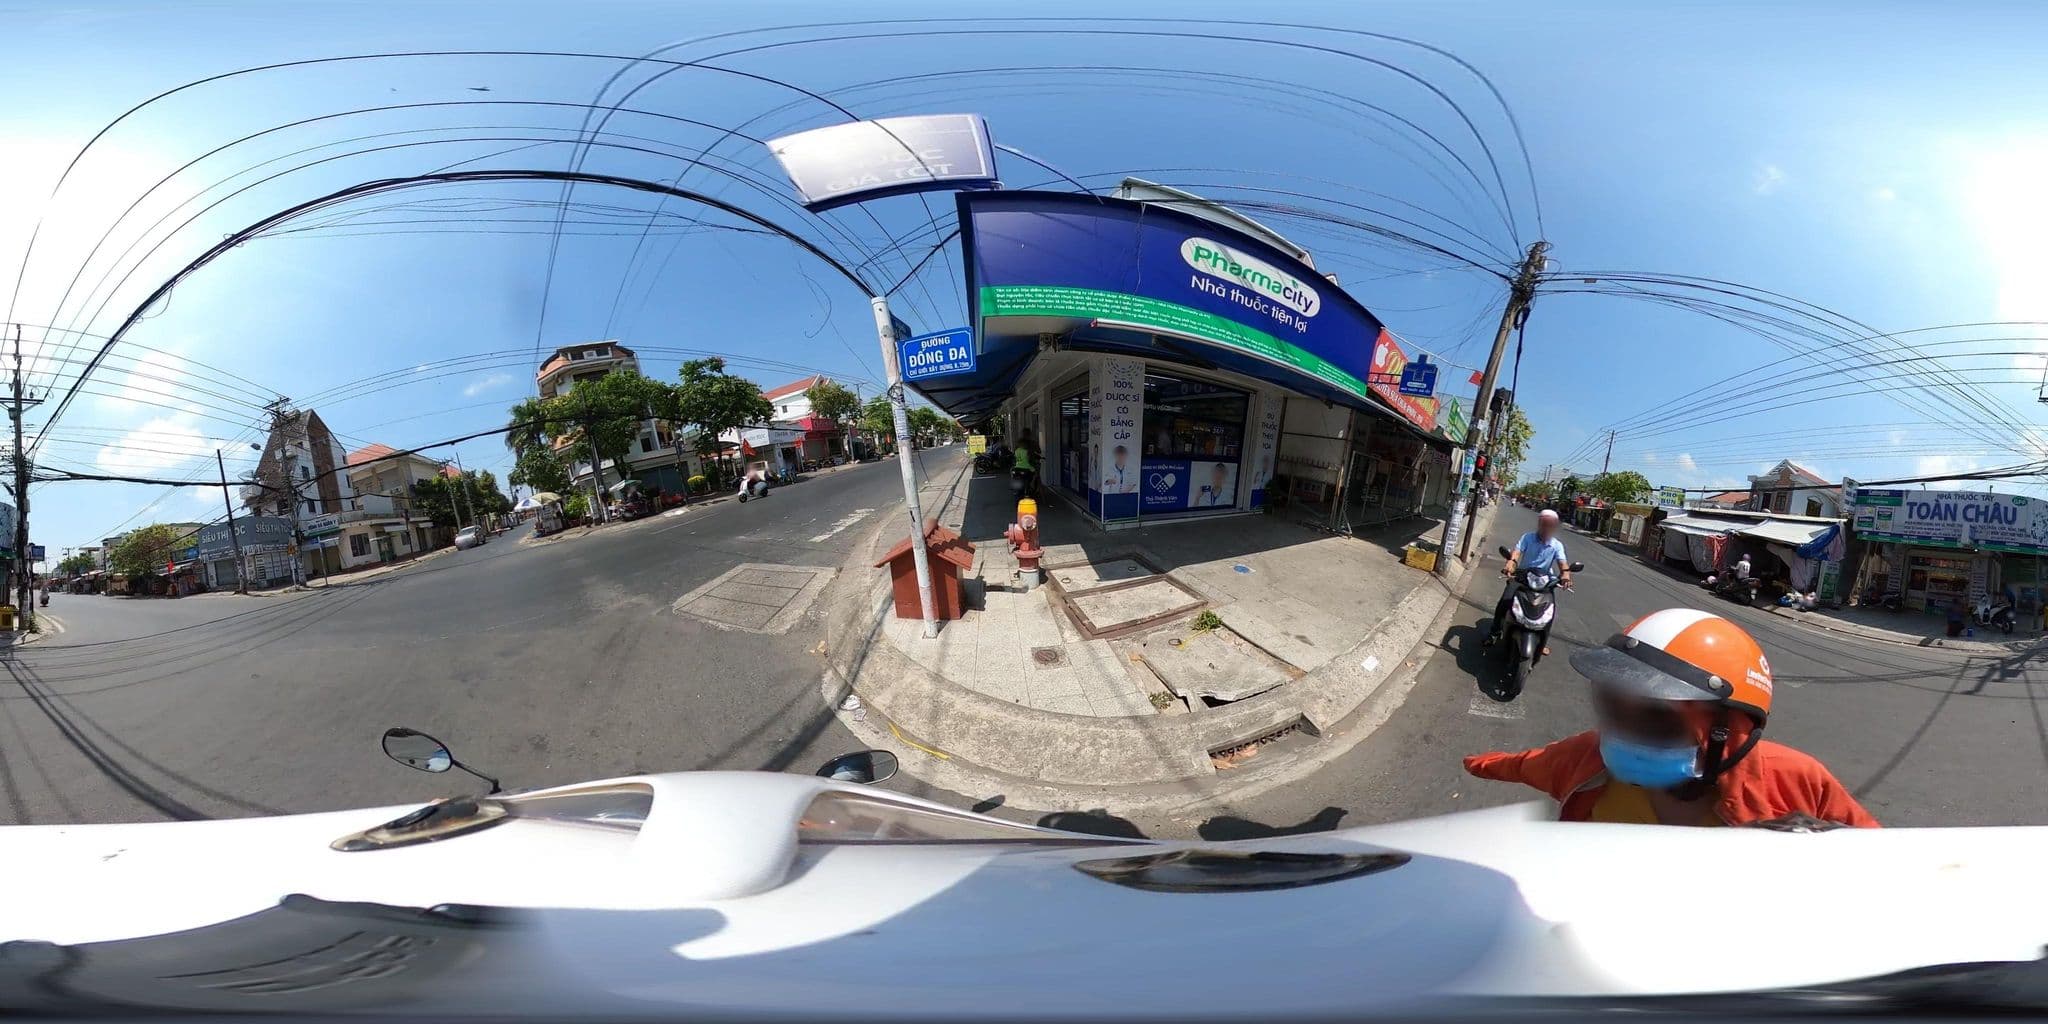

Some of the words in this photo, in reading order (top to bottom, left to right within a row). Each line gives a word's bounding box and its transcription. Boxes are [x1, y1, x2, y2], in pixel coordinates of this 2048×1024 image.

[1193, 245, 1313, 313] Pharmacity
[1191, 275, 1226, 298] Nhà
[1230, 289, 1269, 315] thuốc
[1270, 305, 1293, 327] tiện
[1294, 316, 1307, 334] lợi
[921, 336, 950, 348] ĐƯỜNG
[909, 348, 944, 367] ĐỐNG
[949, 346, 968, 361] ĐA
[1113, 379, 1134, 389] 100%
[1110, 416, 1134, 427] BẰNG
[1114, 428, 1131, 440] CẤP
[1937, 492, 1952, 501] NHÀ
[1954, 492, 1978, 502] THUỐC
[1982, 494, 1995, 502] TÂY
[1907, 499, 1958, 521] TOÀN
[1963, 502, 2018, 525] CHÂU
[202, 531, 216, 544] SIÊU
[216, 529, 229, 541] THỊ
